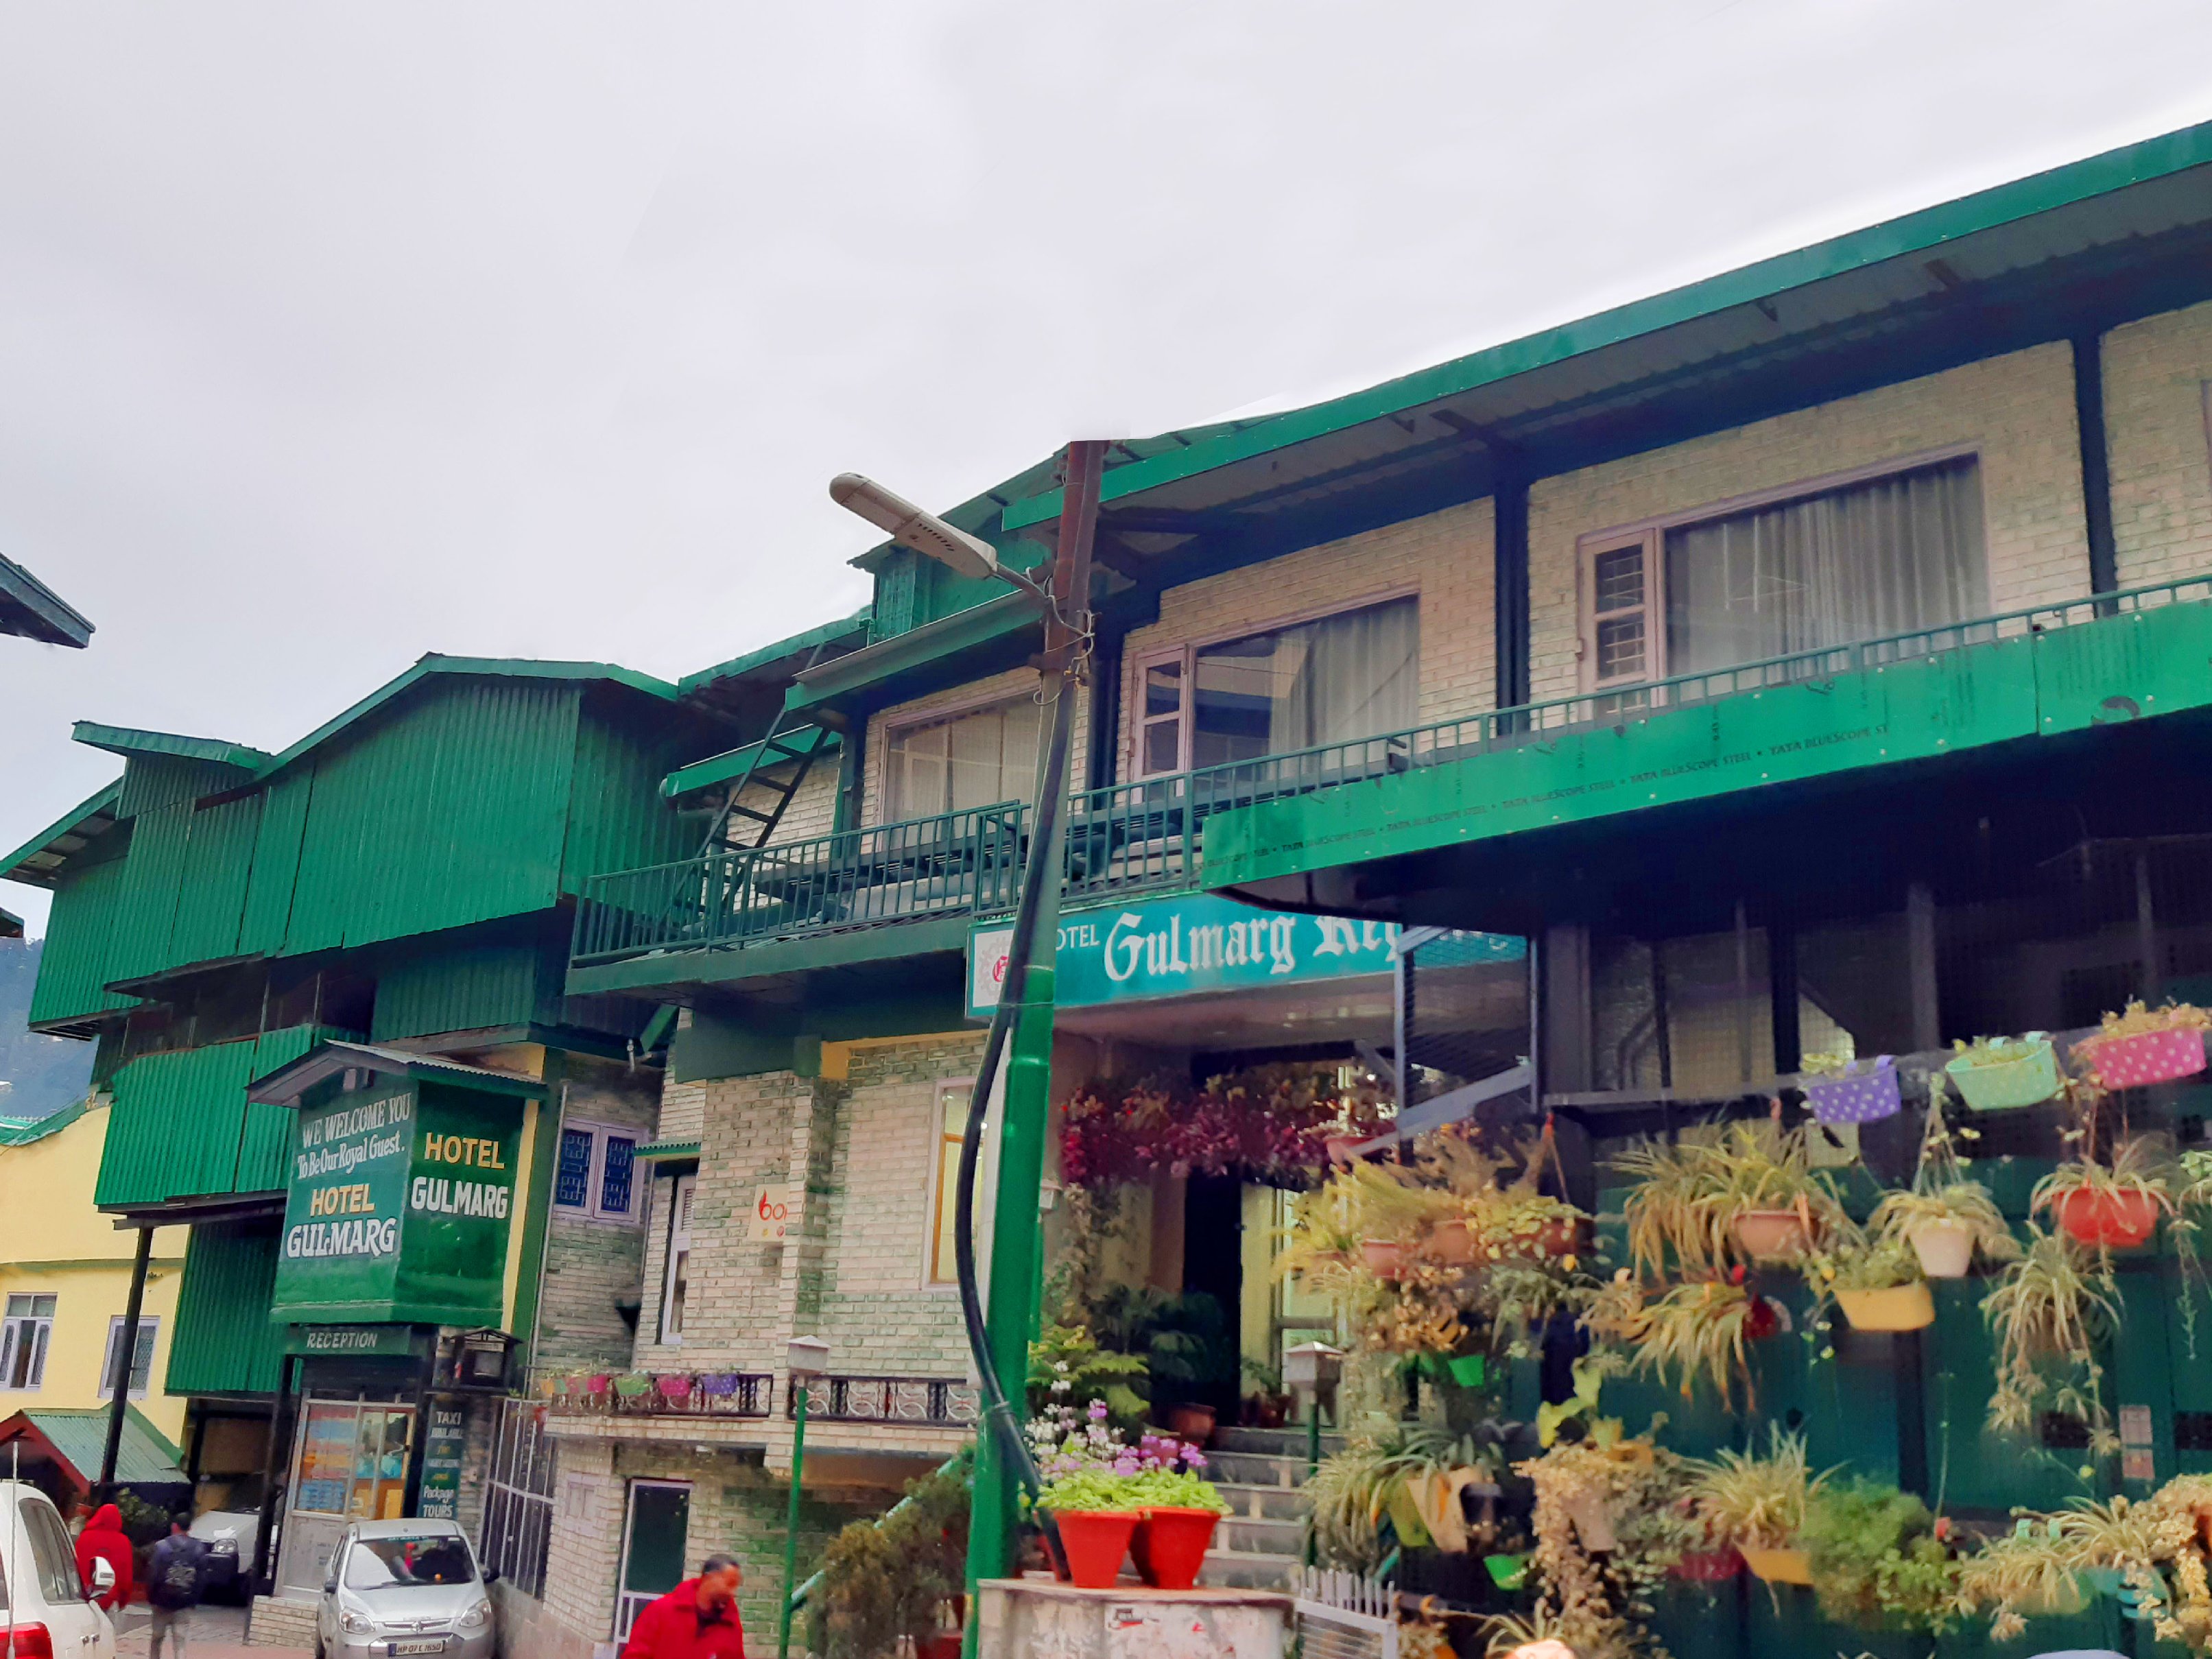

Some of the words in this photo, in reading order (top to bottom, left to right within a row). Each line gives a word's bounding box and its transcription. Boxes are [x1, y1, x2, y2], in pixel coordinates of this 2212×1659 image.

[1056, 924, 1100, 951] OTEL
[302, 1119, 322, 1149] WE
[325, 1099, 386, 1143] WELCOME
[388, 1093, 412, 1125] YOU
[298, 1154, 308, 1180] To
[308, 1151, 320, 1177] Be
[320, 1148, 339, 1173] Our
[339, 1137, 368, 1175] Royal
[424, 1132, 506, 1170] HOTEL
[310, 1183, 375, 1217] HOTEL
[411, 1175, 508, 1219] GULMARG
[287, 1217, 397, 1258] GULMARG
[307, 1332, 378, 1348] RECEPTION
[436, 1411, 462, 1425] TAXI
[423, 1505, 453, 1518] TOURS
